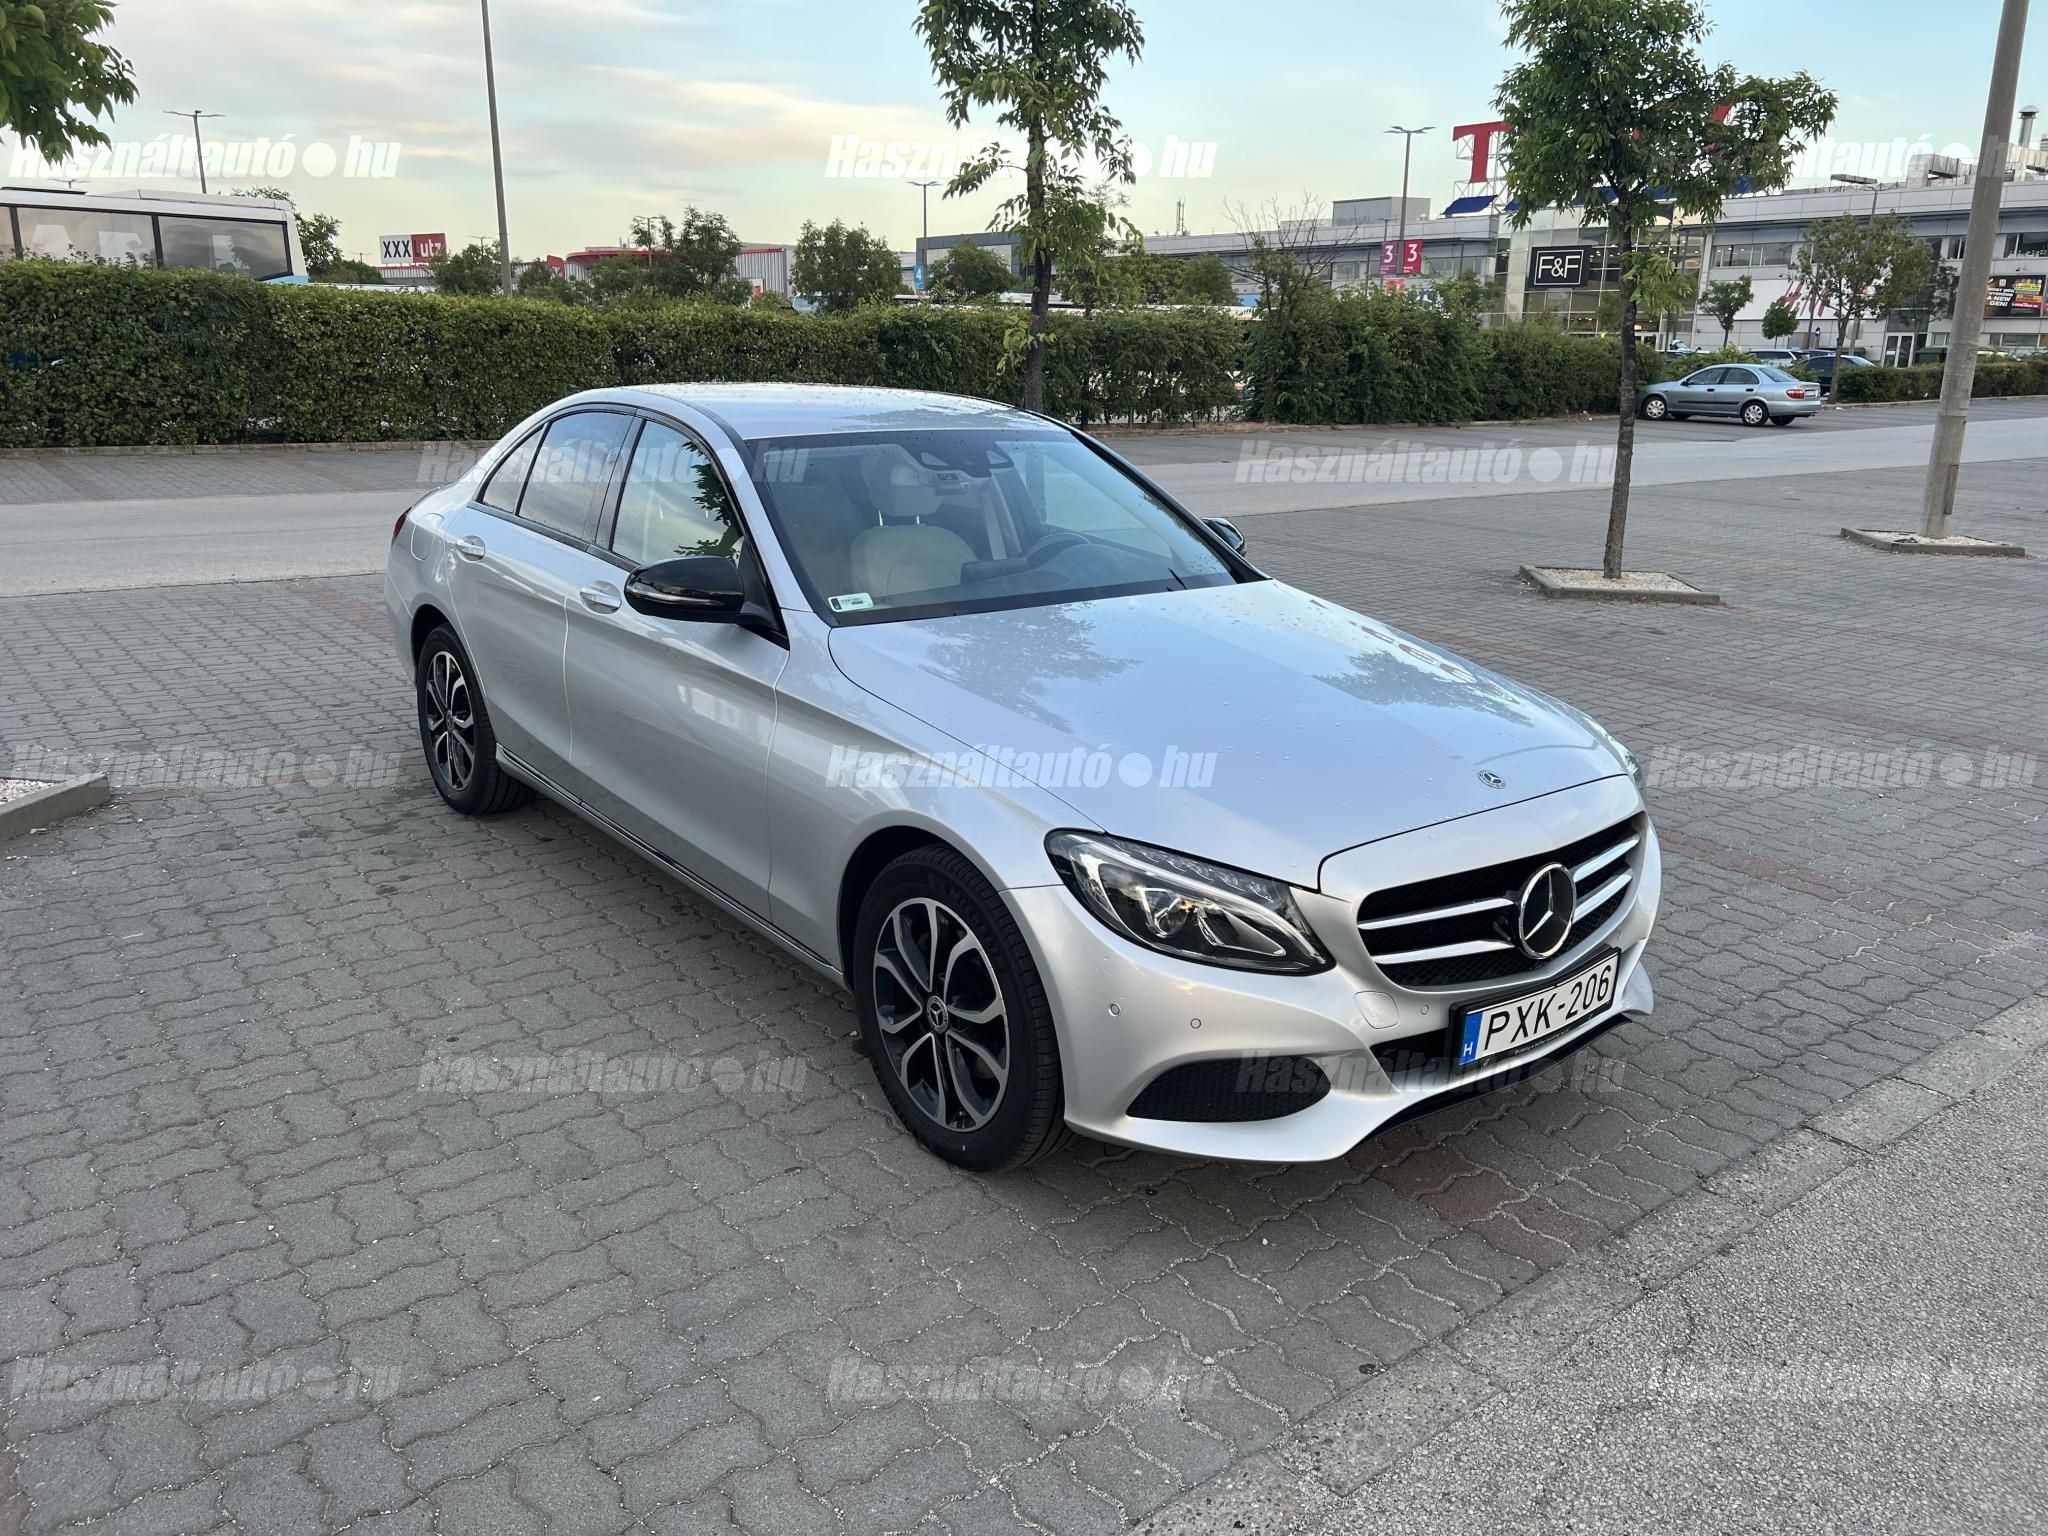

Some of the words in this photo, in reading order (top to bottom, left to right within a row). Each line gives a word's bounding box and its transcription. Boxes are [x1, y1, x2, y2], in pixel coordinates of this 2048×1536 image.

[1384, 245, 1394, 263] 3
[1407, 244, 1418, 262] 3
[1538, 255, 1581, 279] F&F
[1484, 964, 1612, 1051] PXK-206
[1462, 1041, 1473, 1057] H
